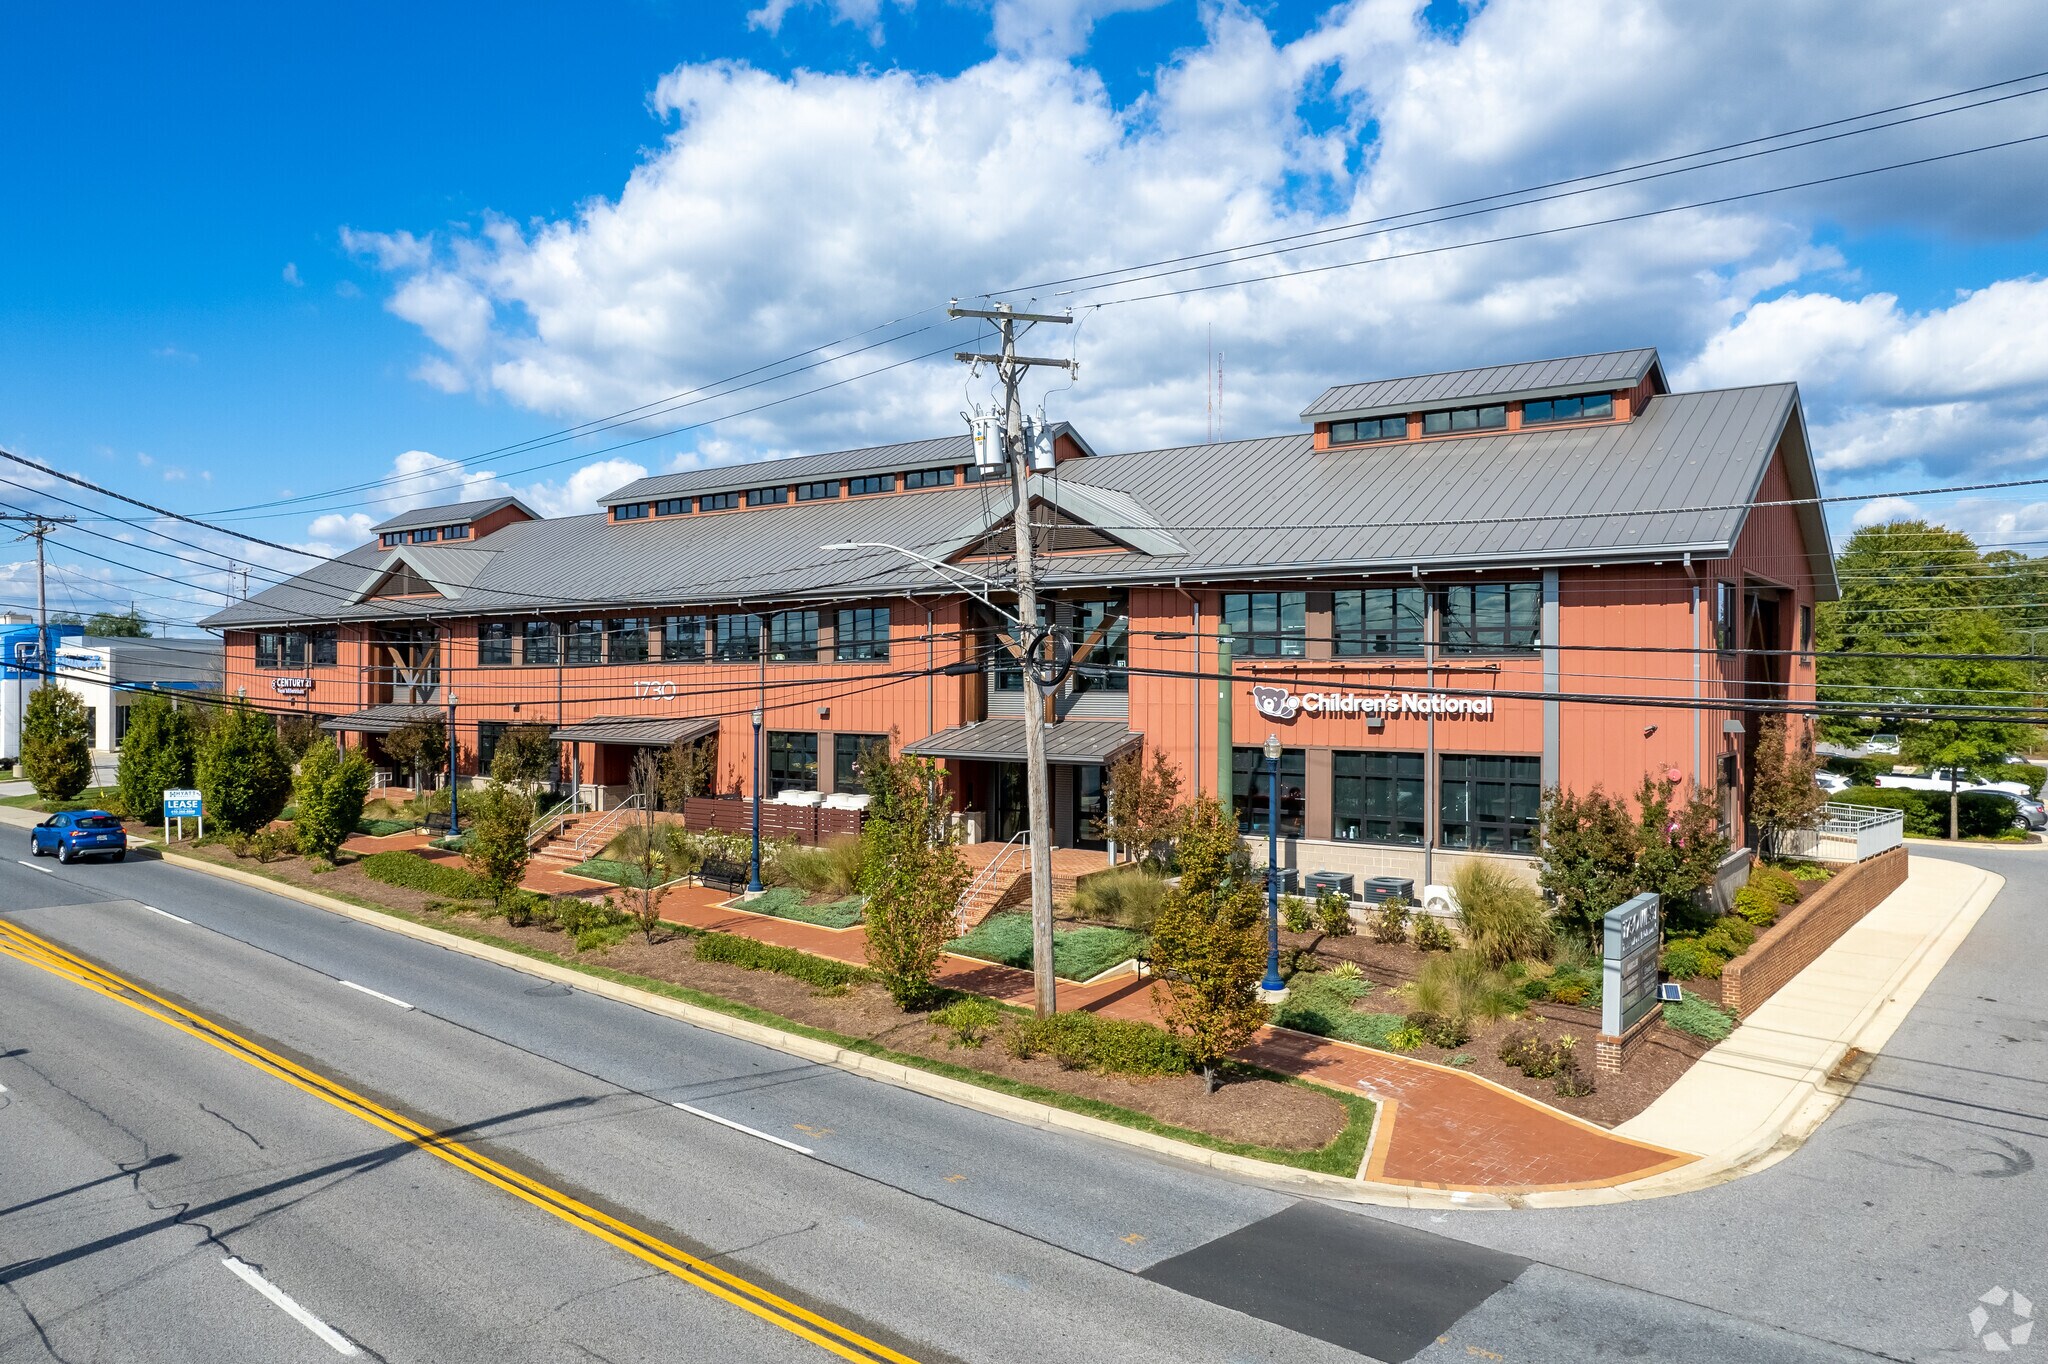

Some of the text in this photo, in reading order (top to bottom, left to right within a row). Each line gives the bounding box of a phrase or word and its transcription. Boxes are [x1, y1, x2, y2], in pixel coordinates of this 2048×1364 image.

[277, 678, 312, 688] CENTURY 21
[633, 680, 677, 701] 1730
[1302, 693, 1494, 714] Children's National
[167, 800, 198, 808] LEASE
